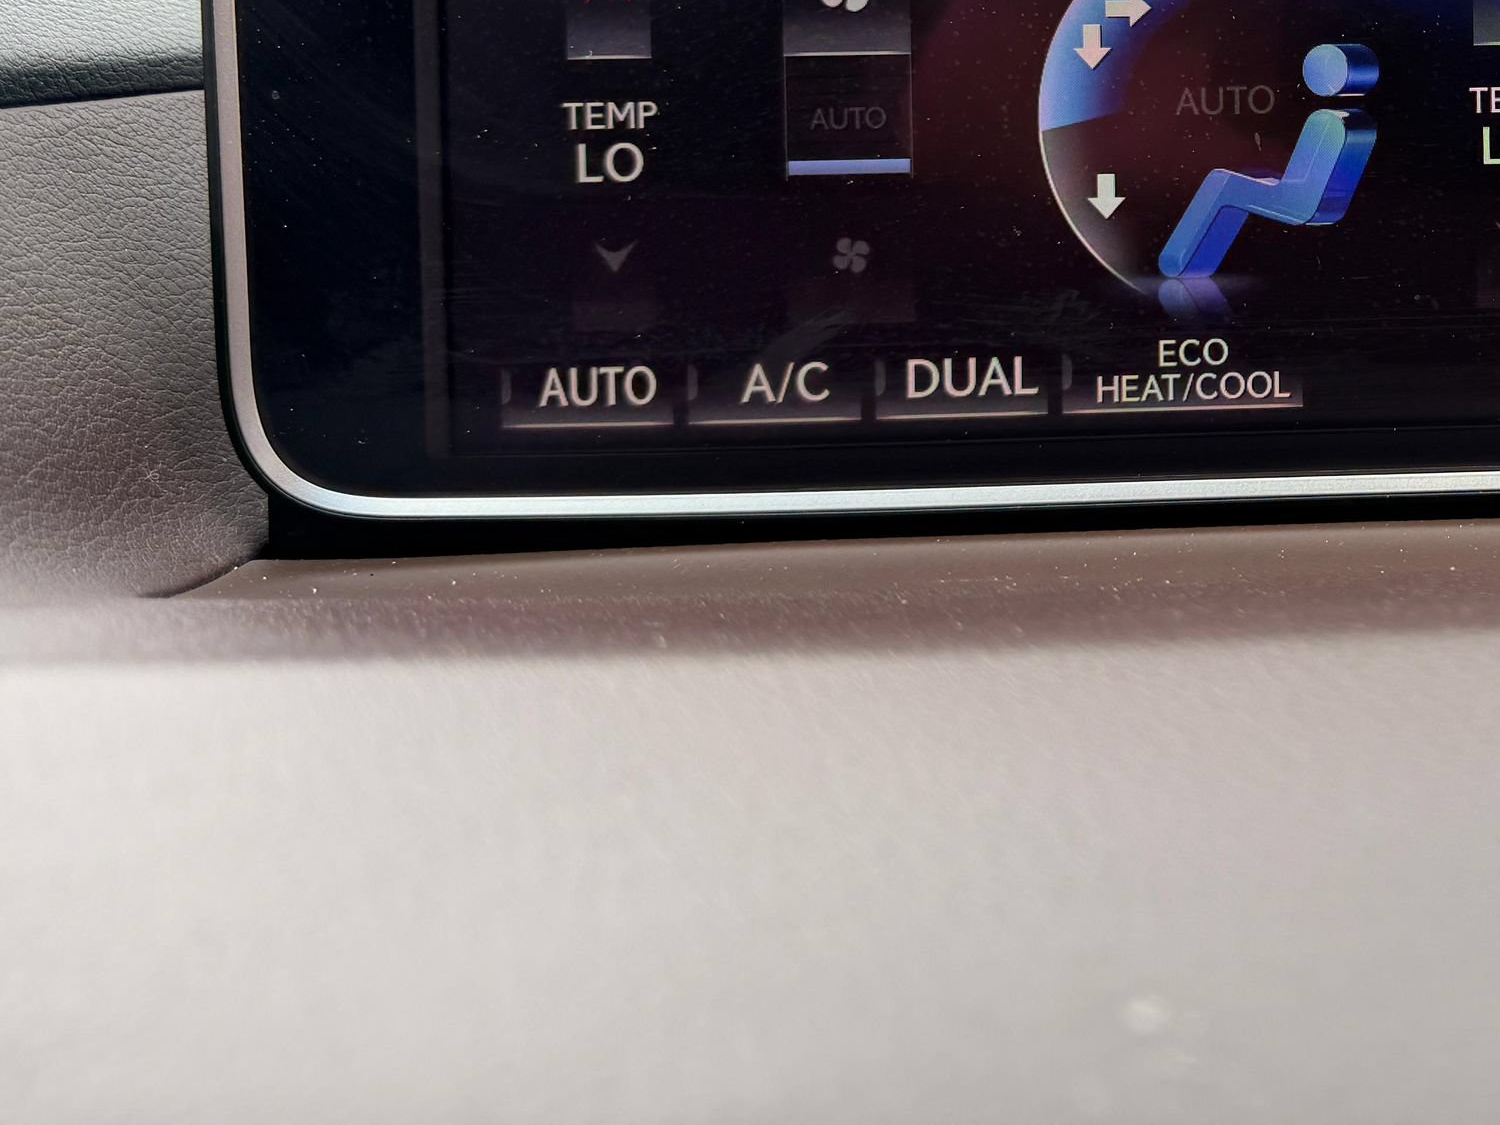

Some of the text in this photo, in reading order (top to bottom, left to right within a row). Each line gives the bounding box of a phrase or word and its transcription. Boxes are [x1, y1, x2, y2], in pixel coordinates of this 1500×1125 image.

[563, 100, 658, 131] TEMP
[1175, 85, 1276, 117] AUTO
[810, 106, 888, 132] AUTO
[574, 141, 645, 184] LO
[1158, 338, 1229, 367] ECO
[538, 365, 658, 408] AUTO
[740, 361, 831, 404] A/C
[905, 356, 1038, 399] DUAL
[1096, 372, 1292, 404] HEAT/COOL
